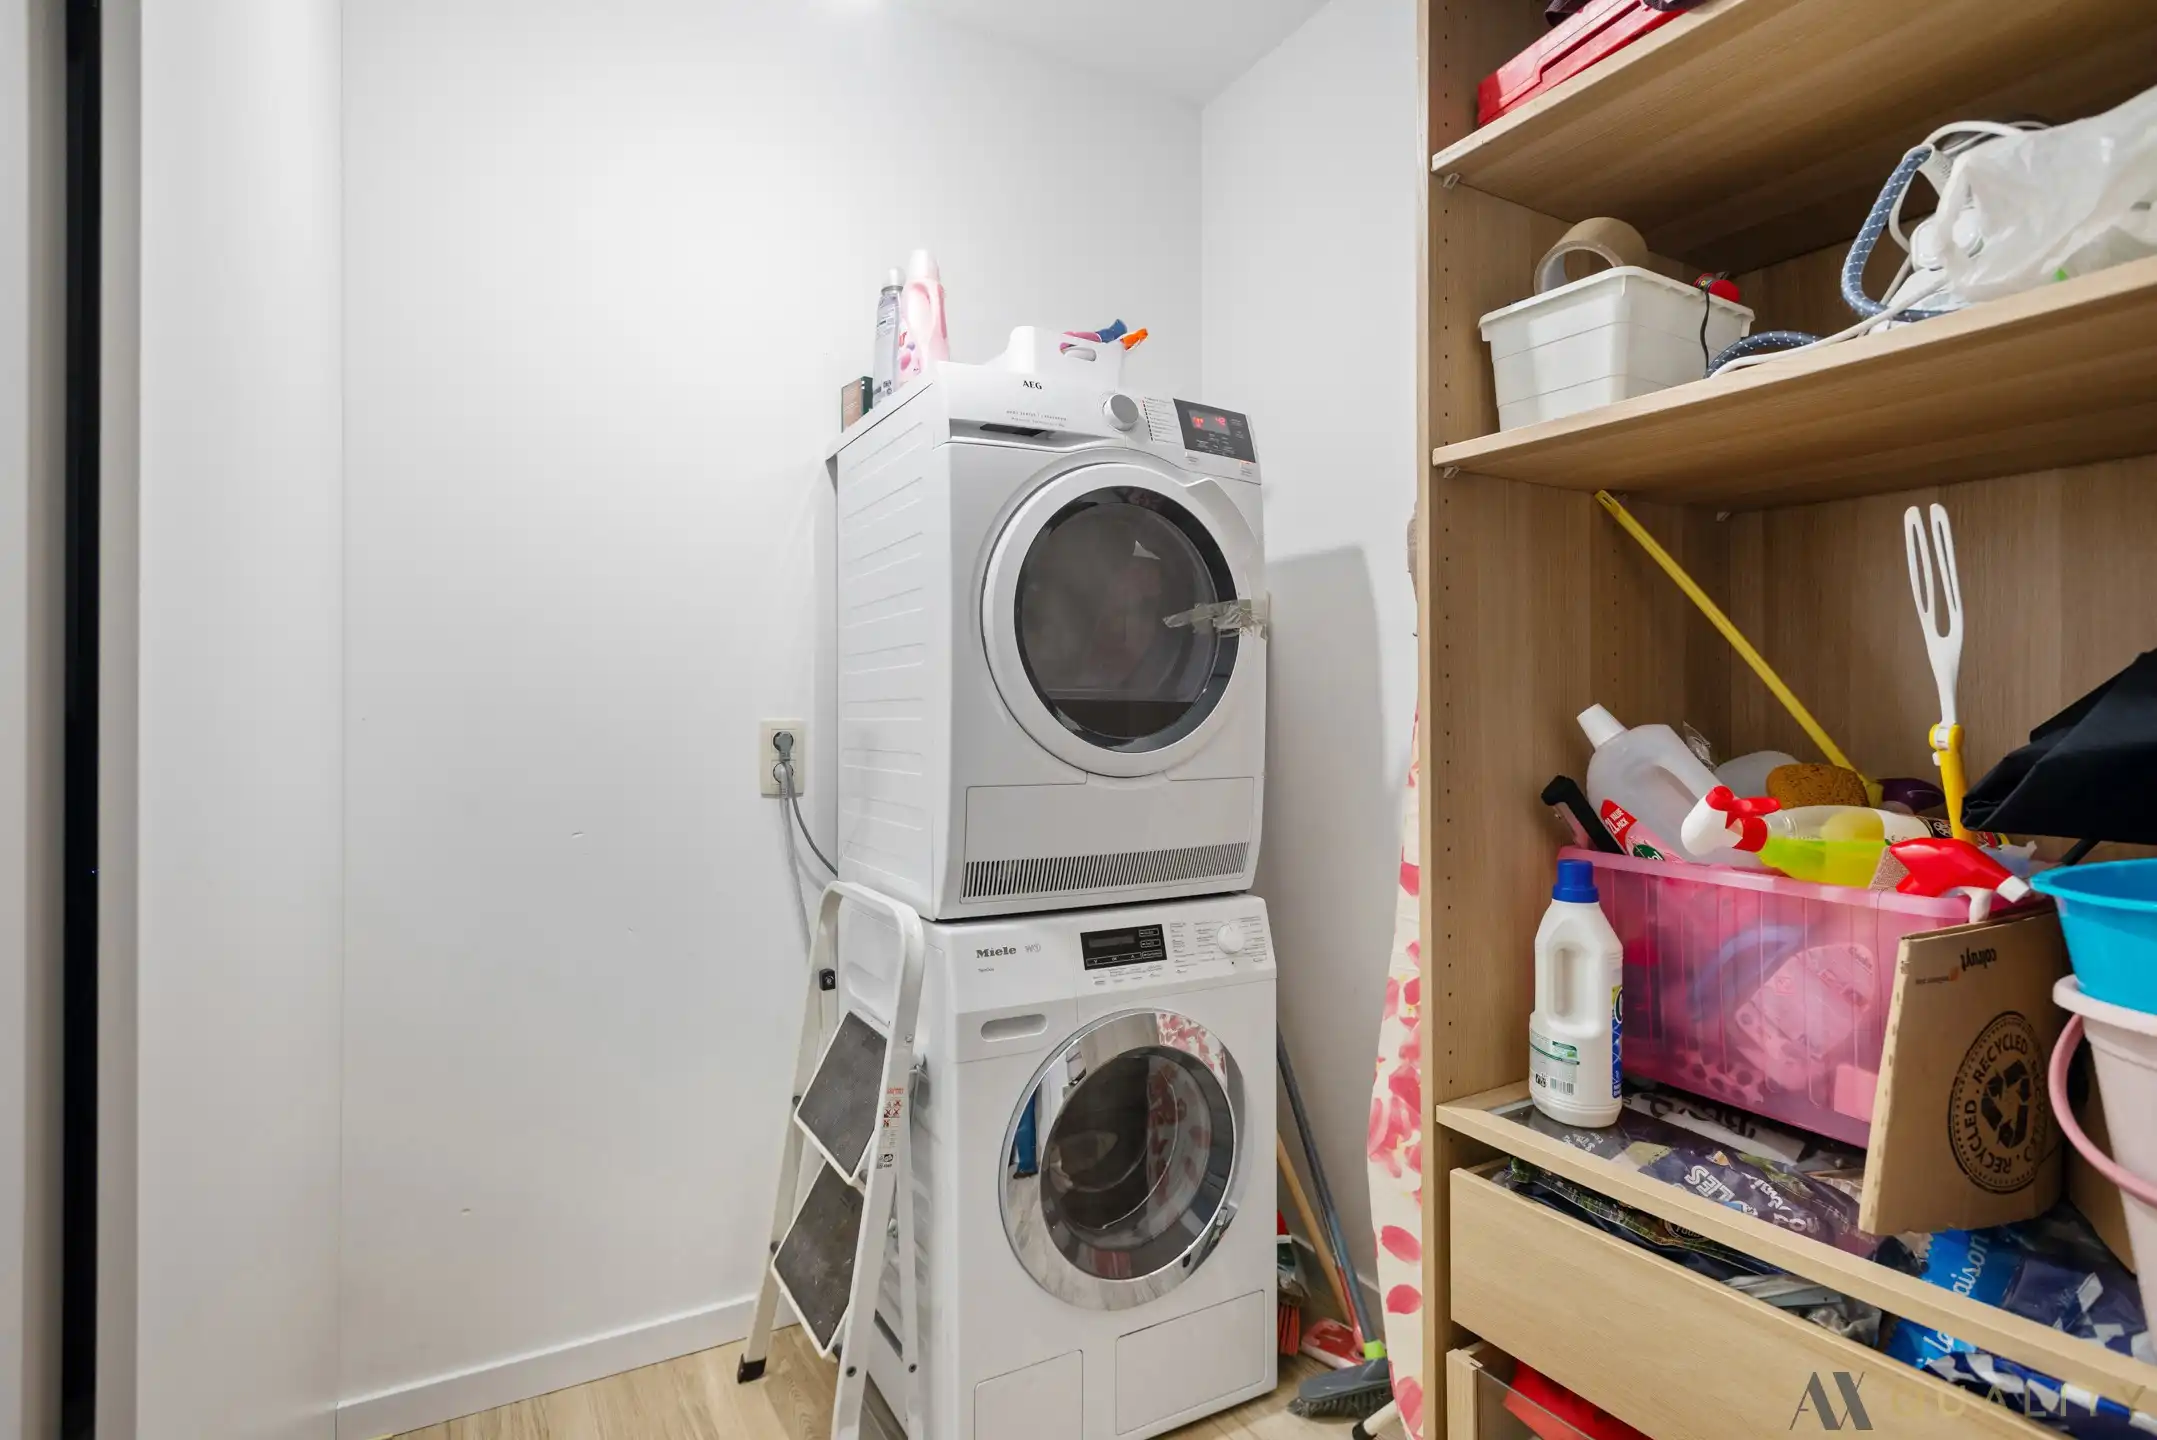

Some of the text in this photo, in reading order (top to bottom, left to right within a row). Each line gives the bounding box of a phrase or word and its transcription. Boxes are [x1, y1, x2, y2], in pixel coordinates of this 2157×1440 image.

[1022, 380, 1043, 390] AEG
[976, 946, 1017, 959] Miele
[1972, 1032, 2029, 1085] RECYCLED
[1964, 1099, 2012, 1175] RECYCLED
[1952, 1233, 1990, 1298] aison
